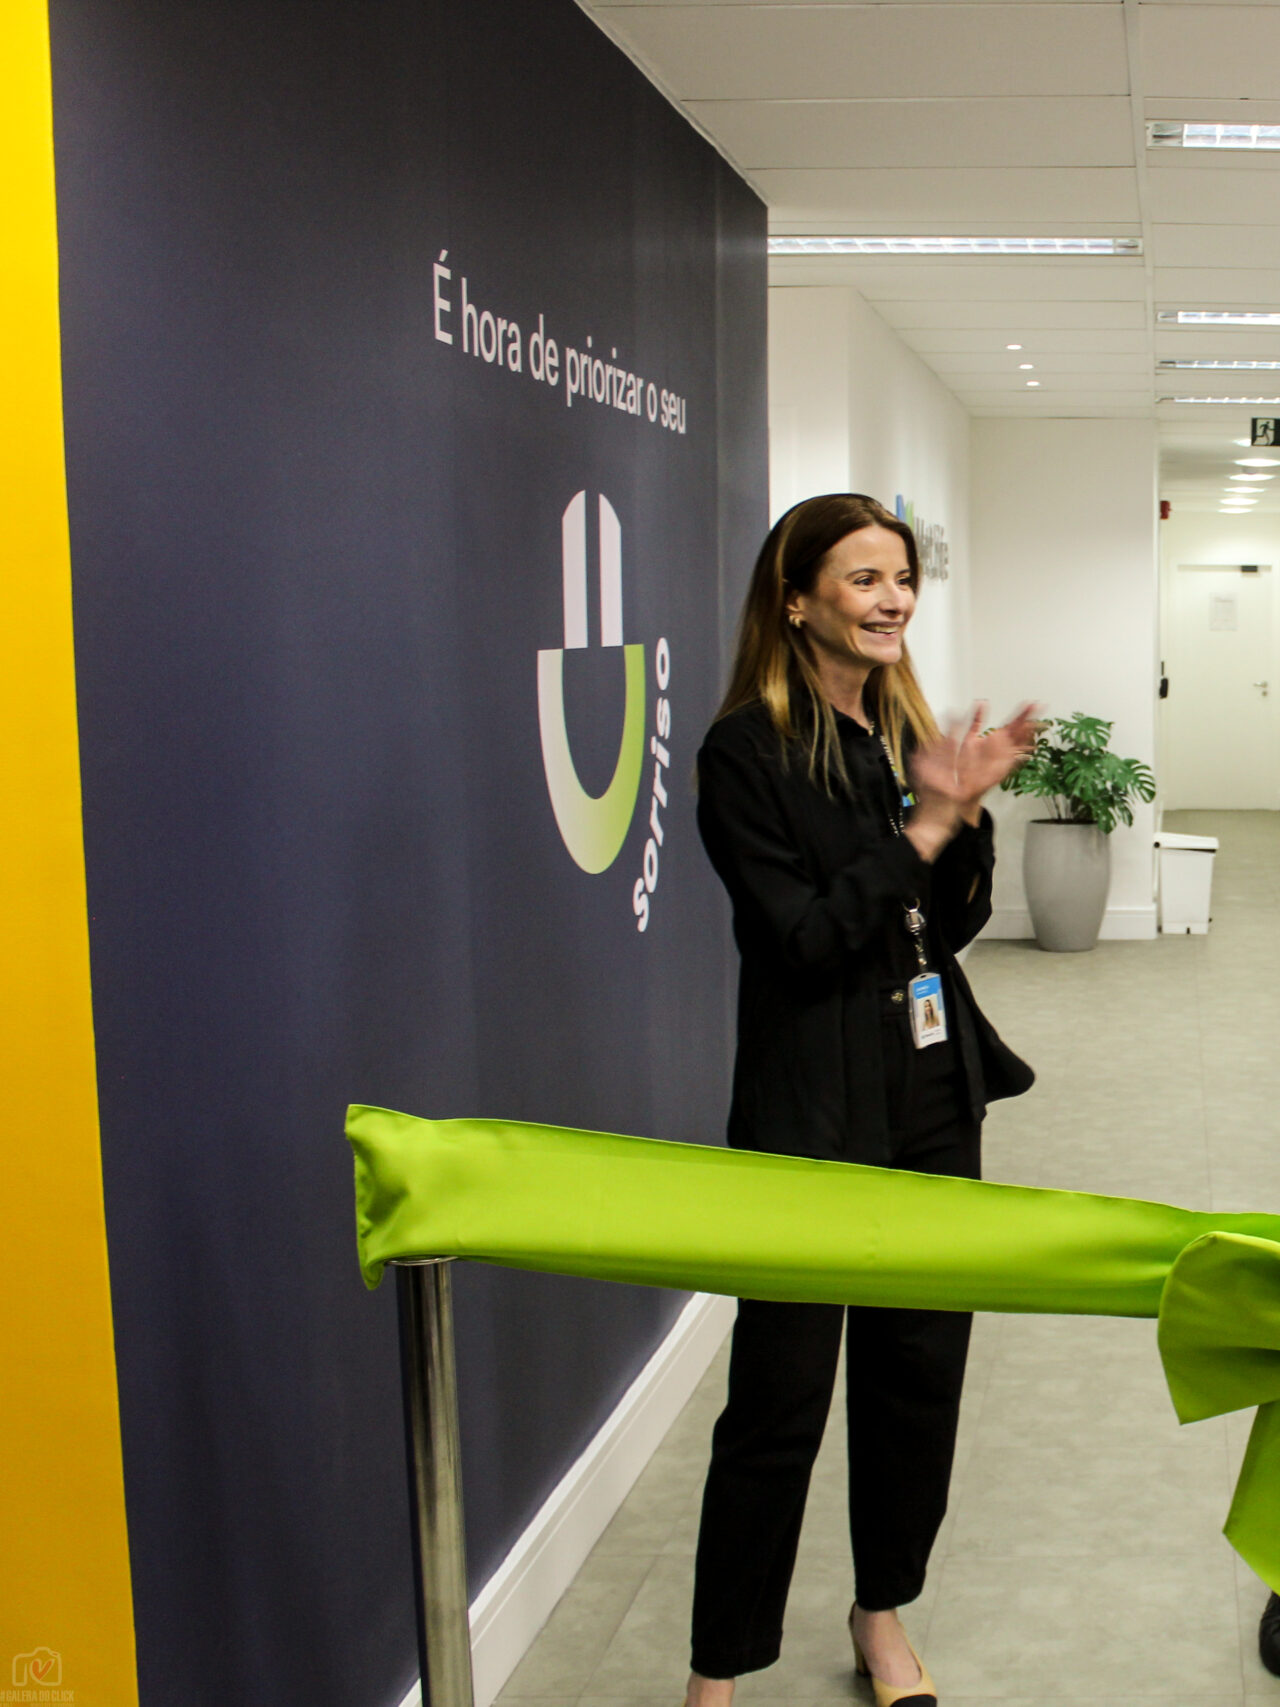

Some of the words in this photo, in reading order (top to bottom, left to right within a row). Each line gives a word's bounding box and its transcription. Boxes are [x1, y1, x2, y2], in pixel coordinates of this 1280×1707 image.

[433, 249, 453, 345] É
[461, 277, 522, 373] hora
[529, 313, 559, 386] de
[565, 335, 643, 417] priorizar
[646, 382, 657, 422] o
[660, 388, 686, 434] seu
[633, 637, 671, 933] sorriso
